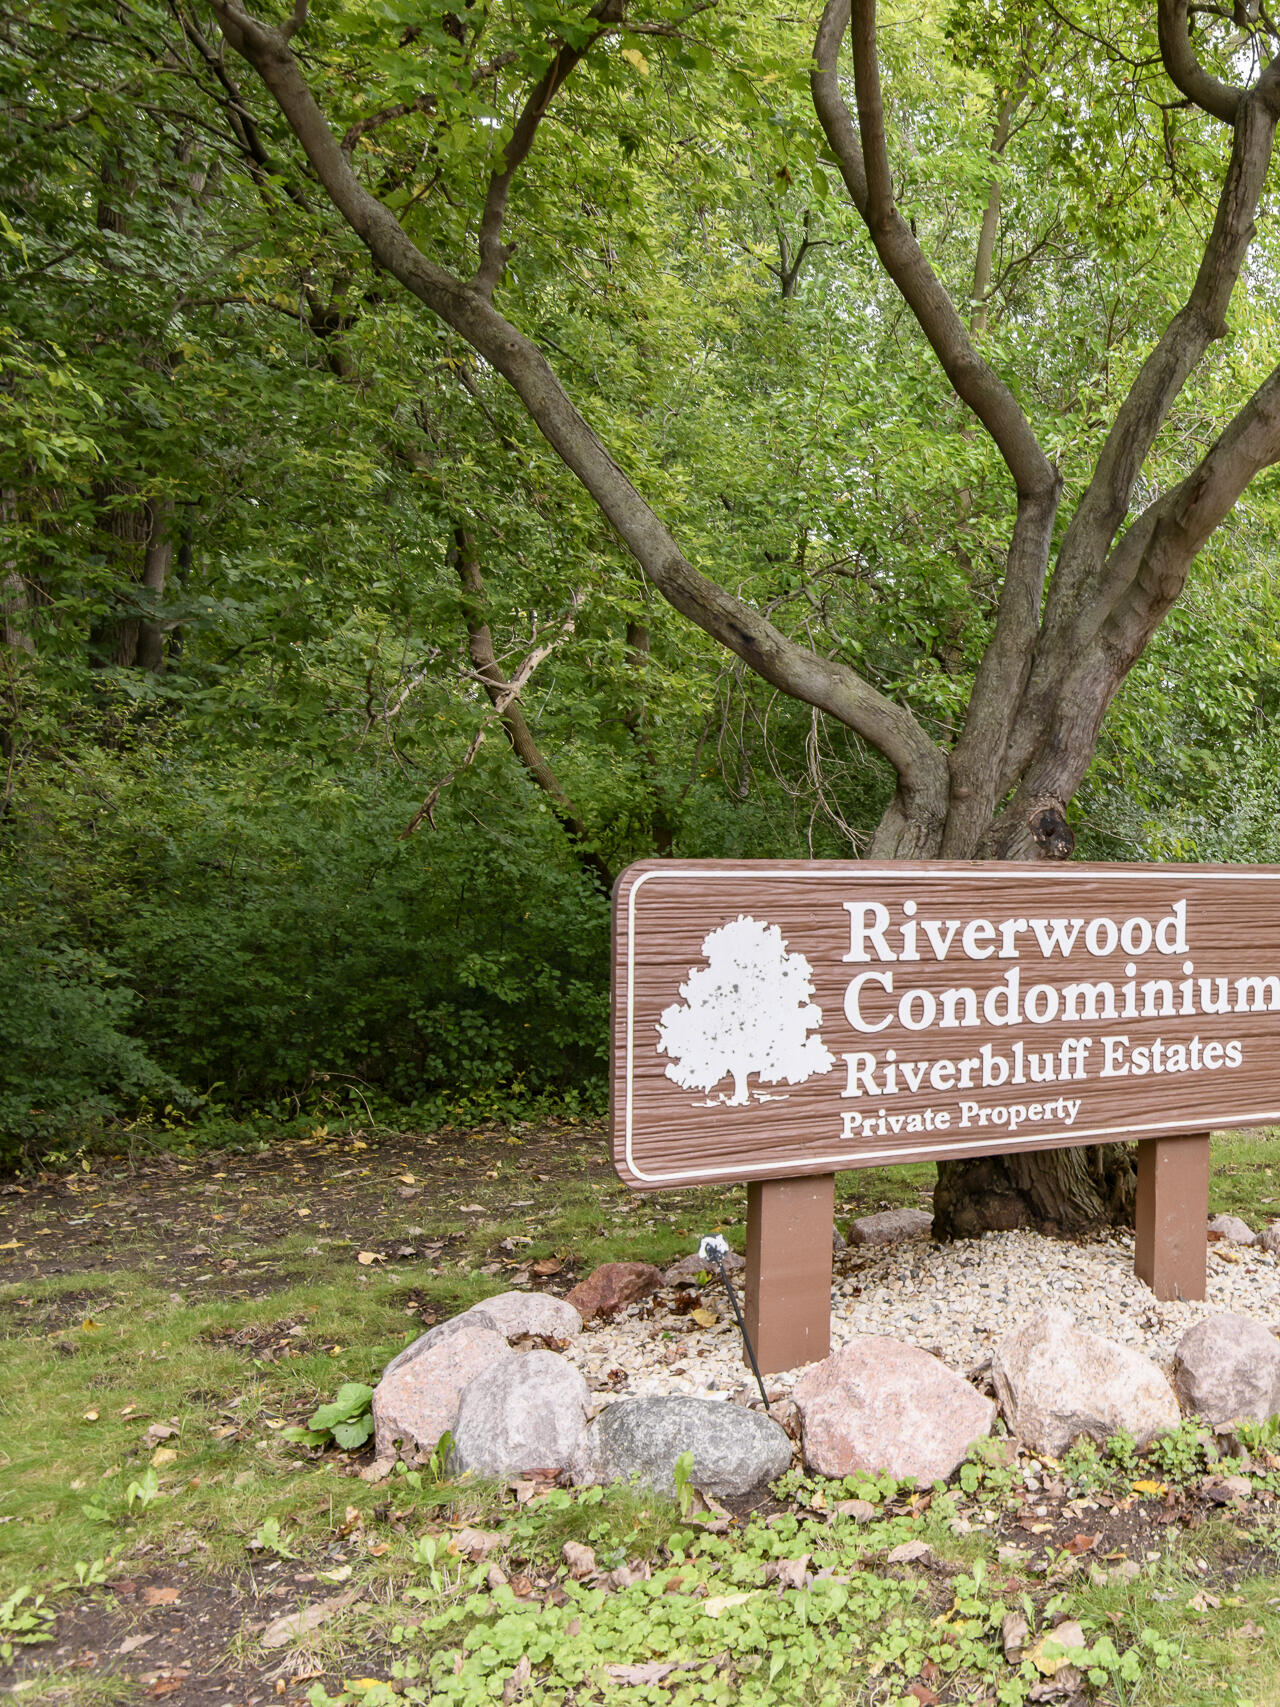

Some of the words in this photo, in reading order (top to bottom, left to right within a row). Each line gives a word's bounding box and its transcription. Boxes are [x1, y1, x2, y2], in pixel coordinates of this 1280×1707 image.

[842, 898, 1190, 963] Riverwood
[841, 1036, 1093, 1098] Riverbluff
[1099, 1035, 1243, 1078] Estates
[840, 1108, 951, 1139] Private
[958, 1097, 1082, 1131] Property
